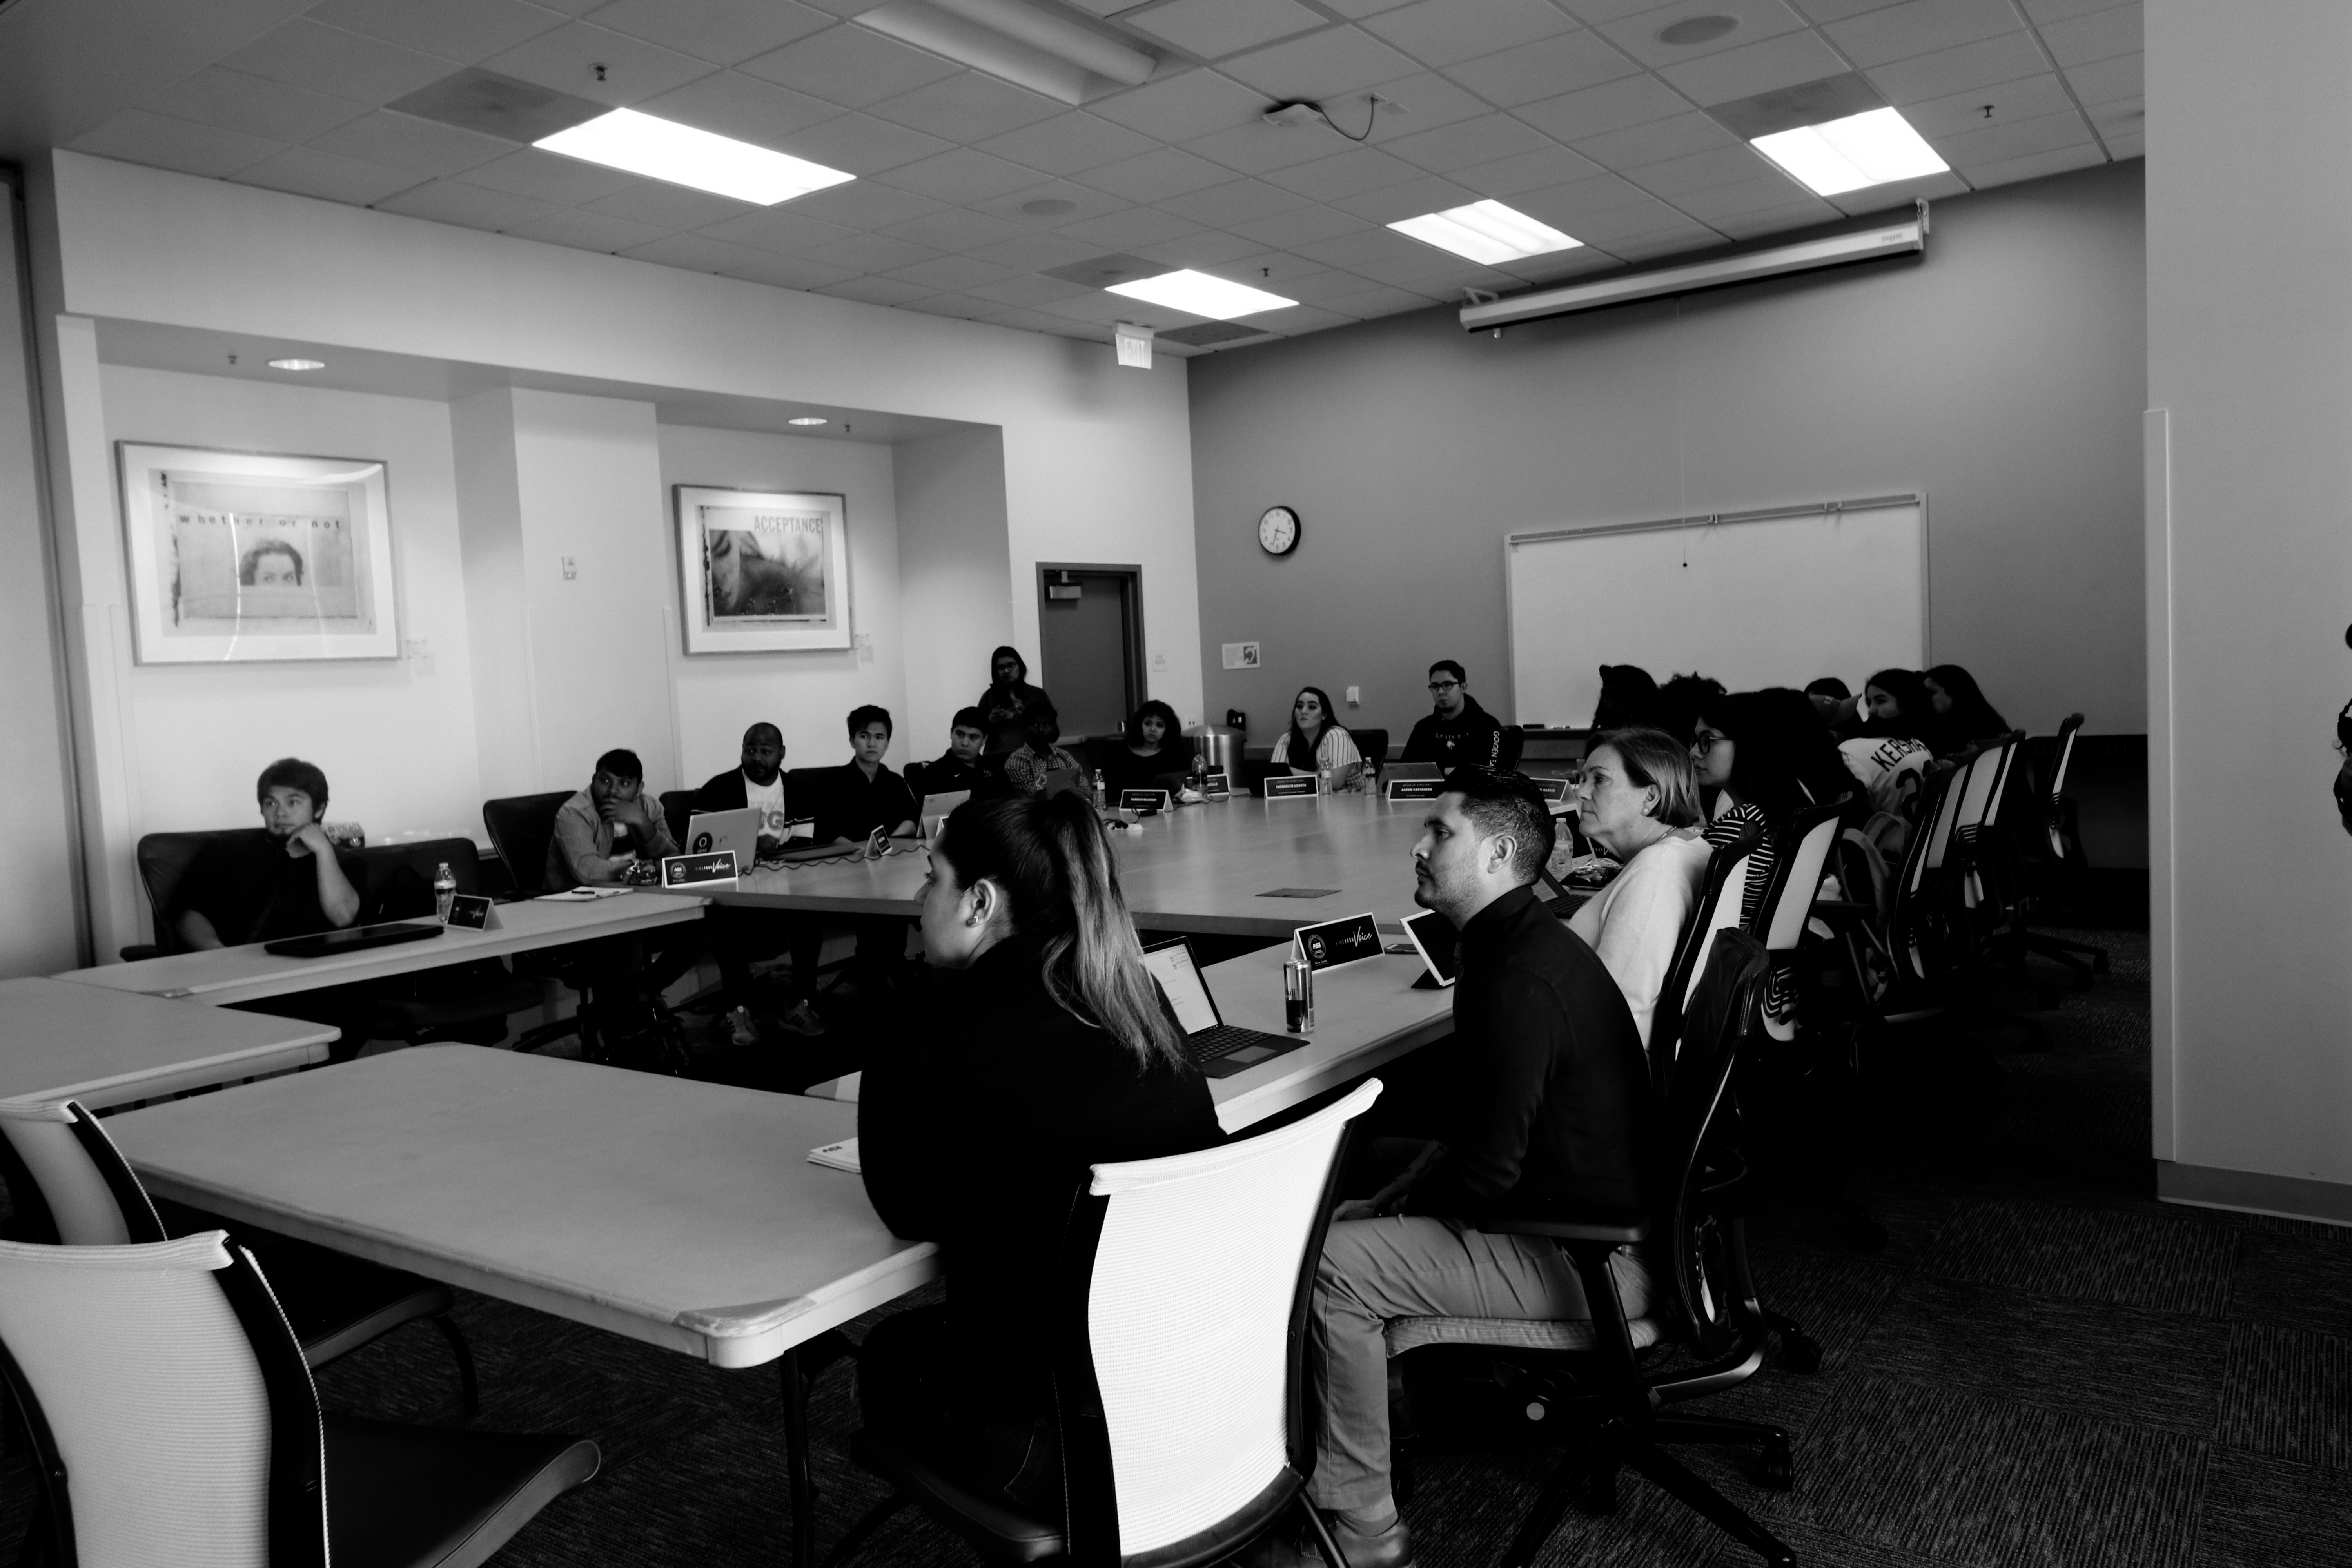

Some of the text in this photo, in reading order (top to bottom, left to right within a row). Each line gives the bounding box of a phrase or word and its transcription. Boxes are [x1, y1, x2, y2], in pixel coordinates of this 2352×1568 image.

[1124, 338, 1145, 367] EXIT
[180, 514, 341, 530] whether or not
[754, 516, 822, 534] ACCEPTANCE
[1491, 730, 1500, 758] GOLDEN
[1353, 926, 1373, 947] Voice
